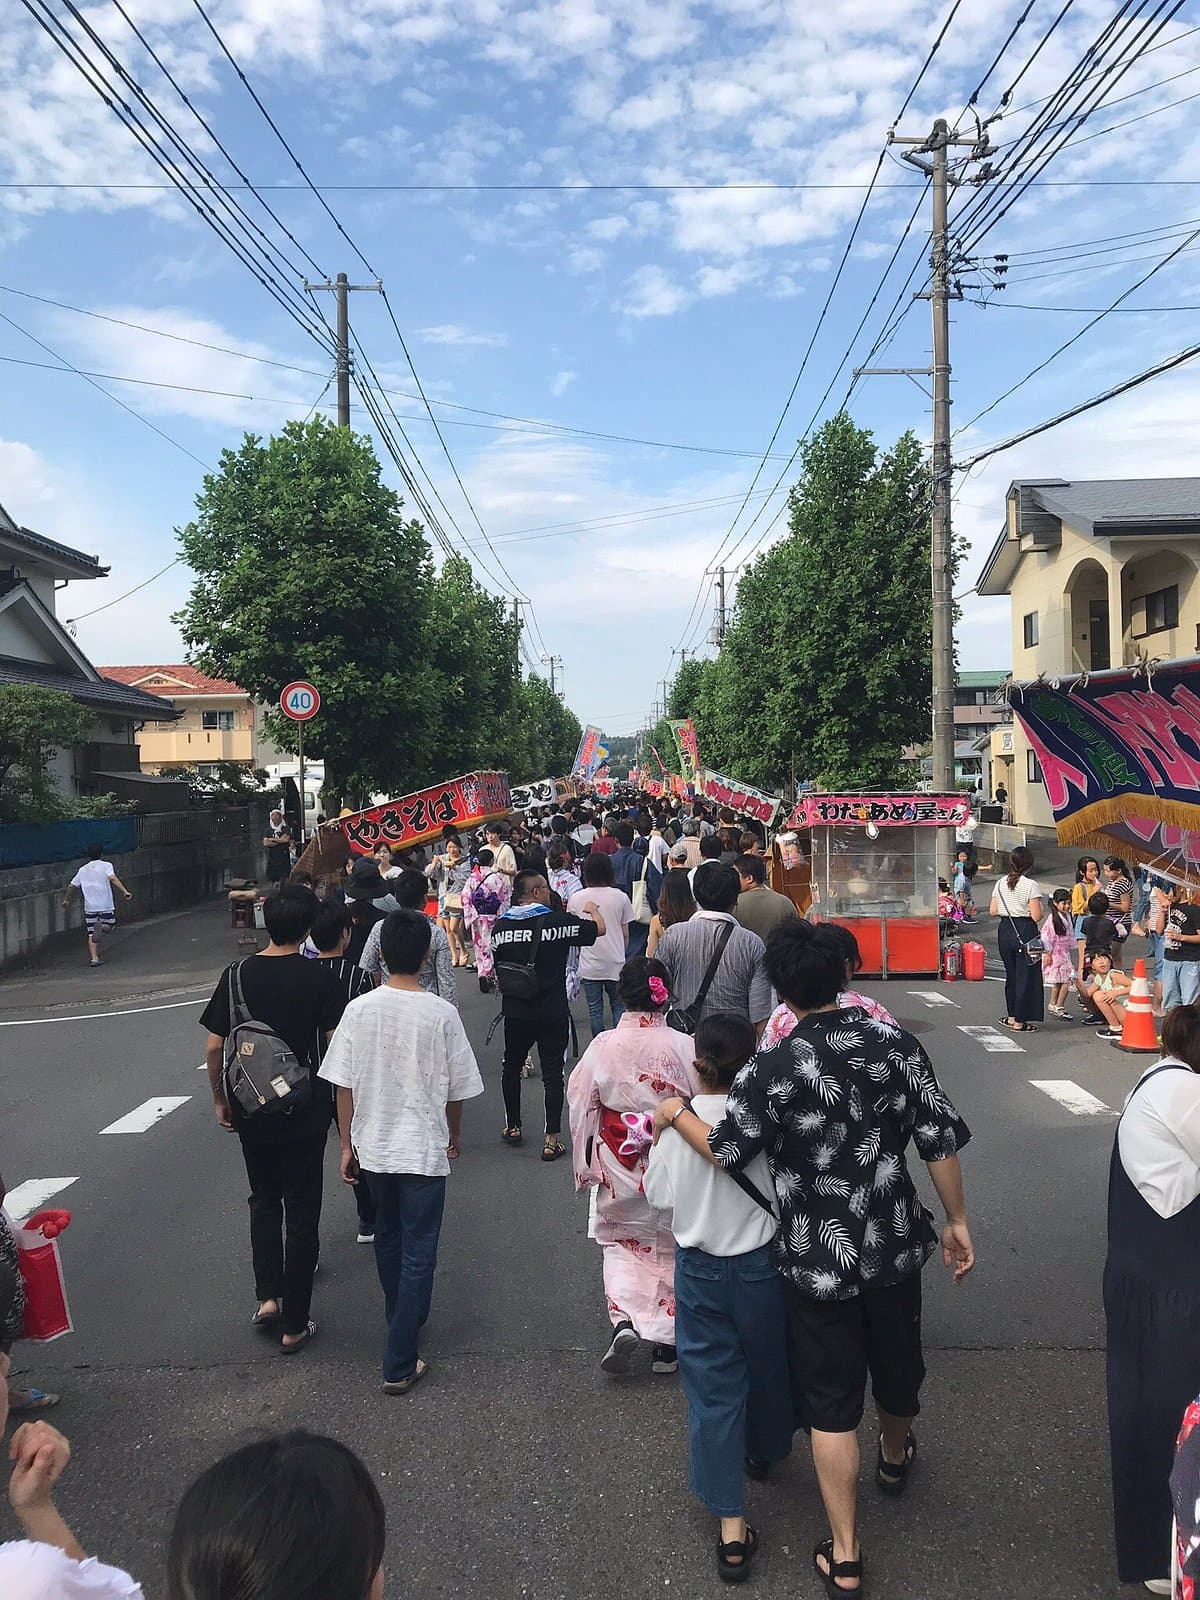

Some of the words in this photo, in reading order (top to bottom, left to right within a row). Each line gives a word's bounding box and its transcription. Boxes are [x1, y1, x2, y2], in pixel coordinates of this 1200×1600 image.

[290, 692, 311, 709] 40
[346, 791, 458, 849] やきそば
[817, 801, 964, 822] わたあめ屋さん
